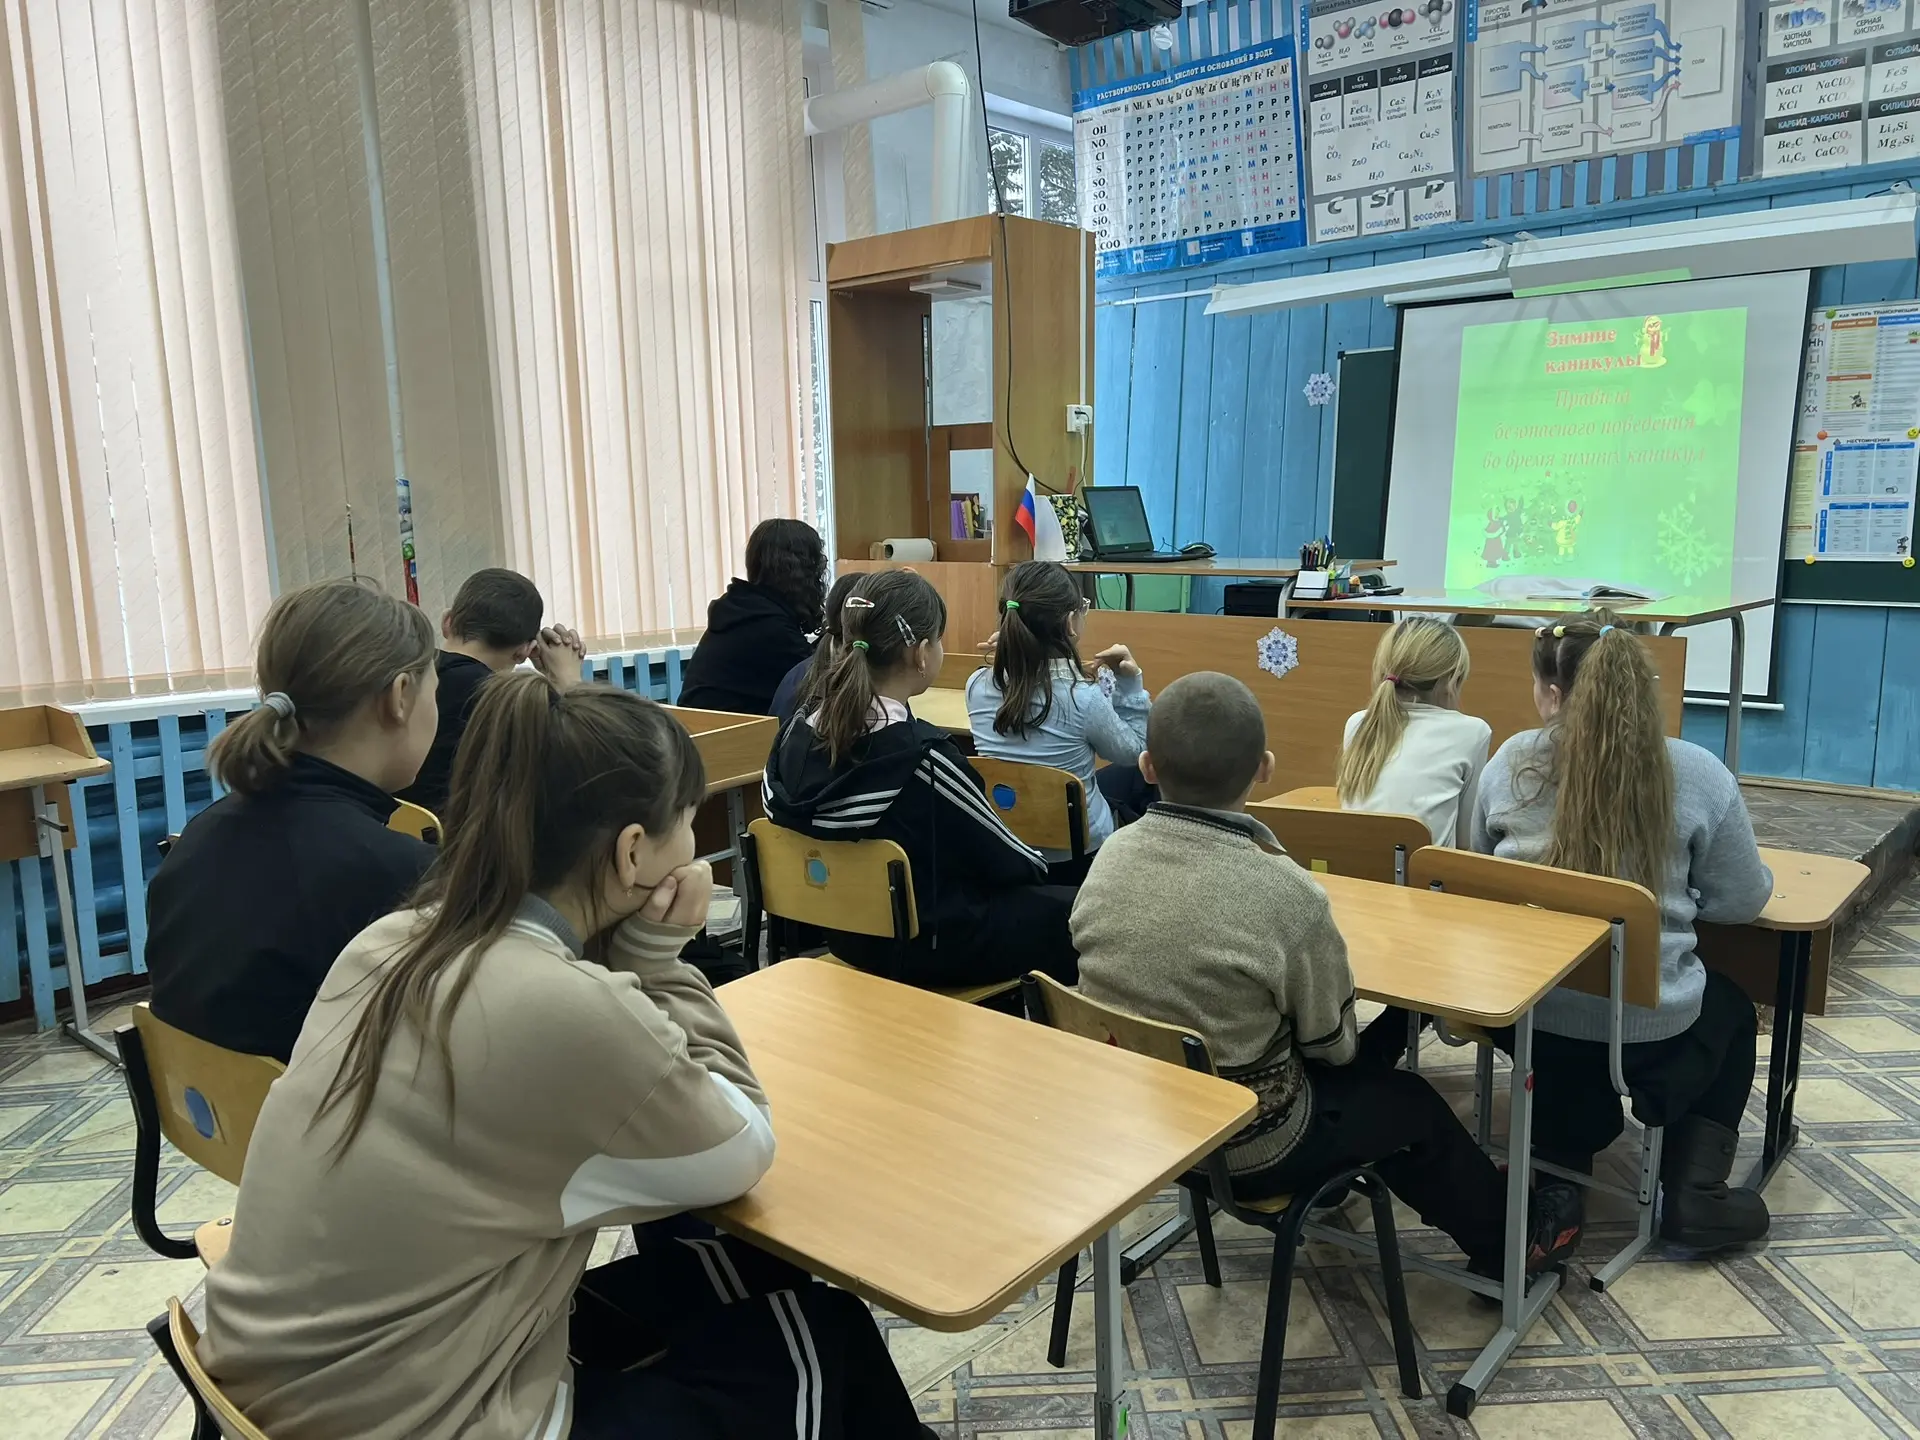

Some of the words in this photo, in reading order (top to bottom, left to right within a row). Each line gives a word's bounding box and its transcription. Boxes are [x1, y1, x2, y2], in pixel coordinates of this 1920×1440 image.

[1485, 5, 1510, 15] ПРОСТЫЕ
[1484, 12, 1511, 23] ВЕЩЕСТВА
[1856, 16, 1882, 27] СЕРНАЯ
[1853, 24, 1884, 35] КИСЛОТА
[1783, 30, 1812, 41] АЗОТНАЯ
[1783, 38, 1812, 49] КИСЛОТА
[1785, 56, 1848, 75] ХЛОРИД-ХЛОРАТ
[1097, 81, 1150, 100] РАСТВОРИМОСТЬ
[1174, 67, 1198, 80] КИСЛОТ
[1207, 54, 1248, 71] ОСНОВАНИЙ
[1256, 47, 1274, 60] ВОДЕ
[1885, 65, 1908, 78] FeS
[1776, 84, 1803, 97] NaCl
[1389, 97, 1406, 106] CaS
[1778, 100, 1798, 111] KCl
[1778, 110, 1850, 129] КАРБИД-КАРБОНАТ
[1092, 125, 1107, 135] OH
[1778, 137, 1803, 149] Be2C
[1095, 152, 1104, 161] Cl
[1351, 157, 1367, 167] ZnO
[1096, 165, 1102, 173] S
[1326, 173, 1342, 182] BaS
[1368, 171, 1384, 181] H2O
[1424, 180, 1446, 200] P
[1370, 186, 1398, 208] Si
[1327, 196, 1345, 215] C
[1413, 210, 1452, 222] ФОСФОРУМ
[1546, 328, 1617, 348] Зимние
[1808, 338, 1824, 347] Hh
[1545, 354, 1642, 375] каникулы
[1806, 372, 1820, 384] Pp
[1555, 387, 1631, 411] Правила
[1806, 389, 1818, 398] Tt
[1804, 405, 1818, 413] Xx
[1494, 420, 1595, 441] безопасного
[1601, 414, 1695, 435] поведения
[1482, 453, 1500, 469] во
[1505, 450, 1554, 472] время
[1561, 447, 1621, 466] зимних
[1627, 444, 1706, 465] каникул
